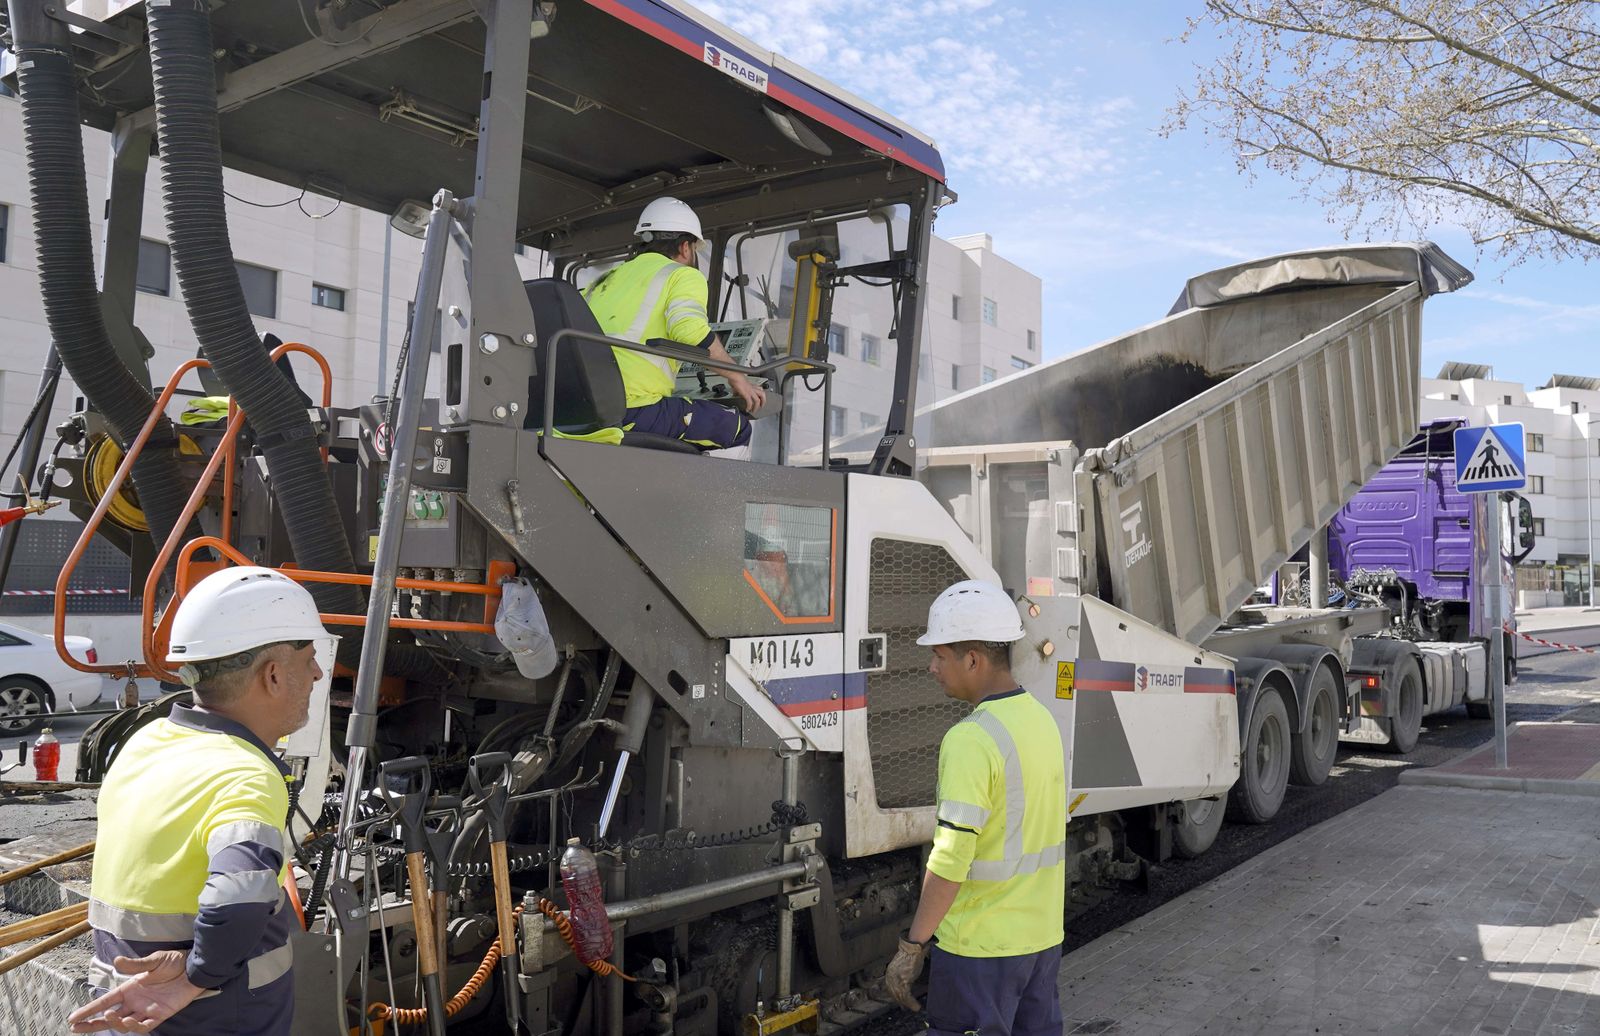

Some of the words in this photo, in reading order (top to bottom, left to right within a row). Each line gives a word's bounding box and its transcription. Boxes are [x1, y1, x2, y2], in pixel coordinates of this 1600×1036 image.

[722, 57, 766, 87] TRABIT
[1353, 502, 1409, 512] VOLVO
[1149, 673, 1183, 687] TRABIT
[801, 711, 838, 730] 5802429
